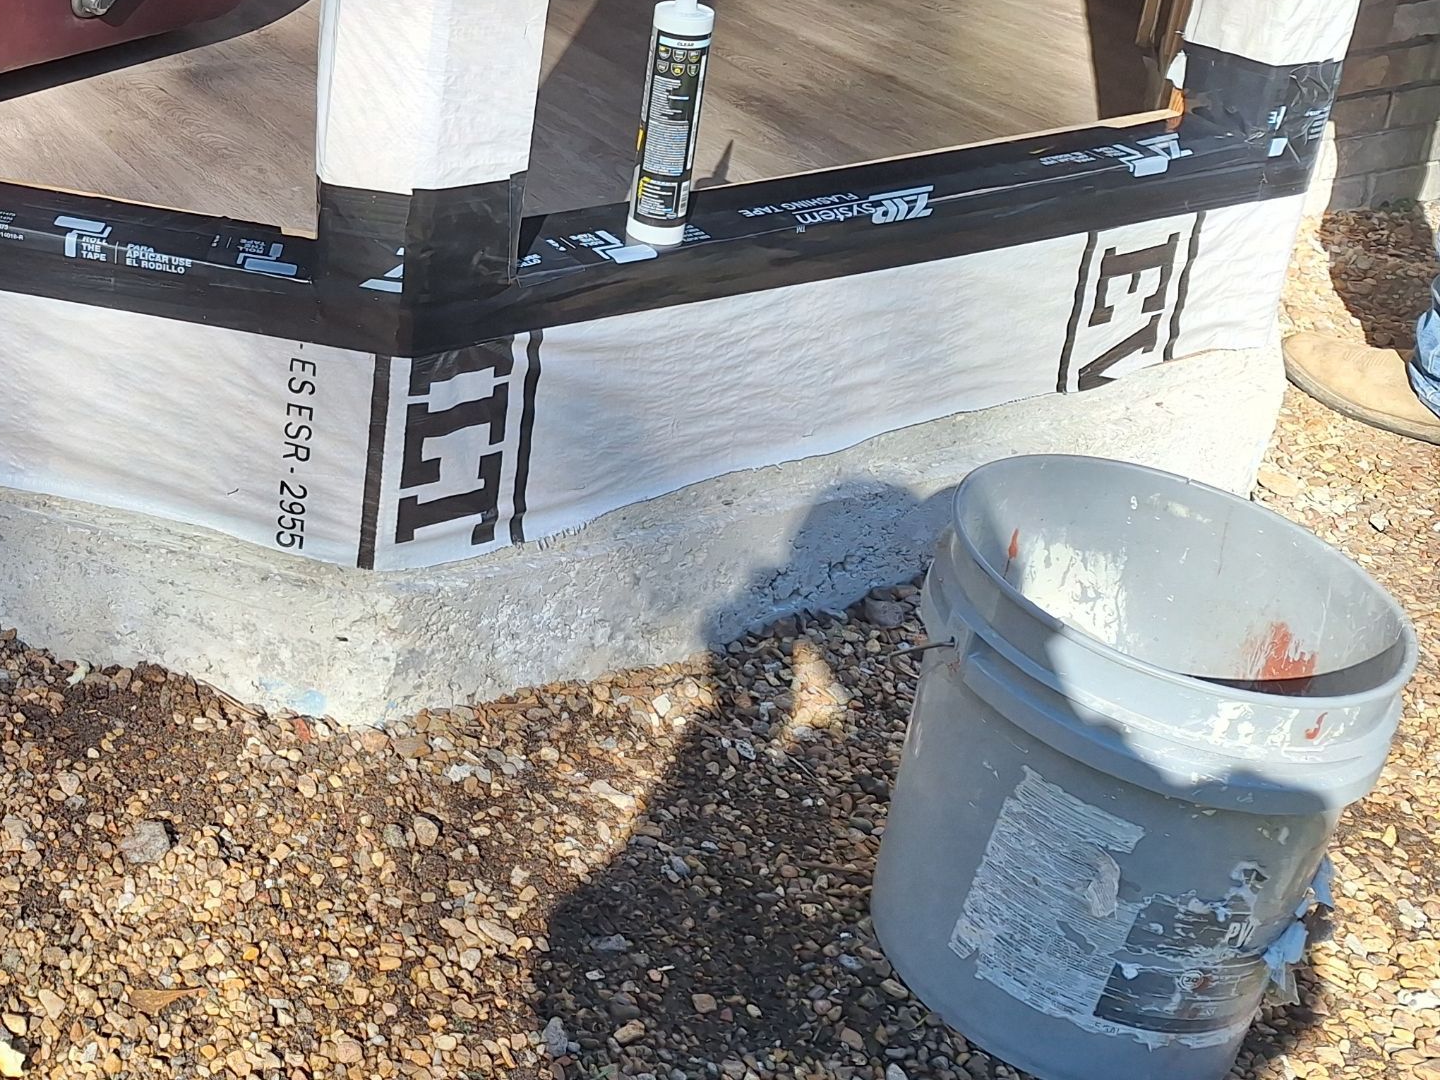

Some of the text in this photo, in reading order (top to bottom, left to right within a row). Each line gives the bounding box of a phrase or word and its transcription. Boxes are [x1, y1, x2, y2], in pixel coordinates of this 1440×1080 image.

[737, 192, 860, 219] FLASHING TAPE
[82, 236, 109, 246] ROLL
[82, 242, 101, 252] THE
[127, 243, 155, 253] PARA
[81, 250, 107, 262] TAPE
[126, 251, 192, 268] APLICAR USE
[126, 258, 186, 274] EL RODILLO
